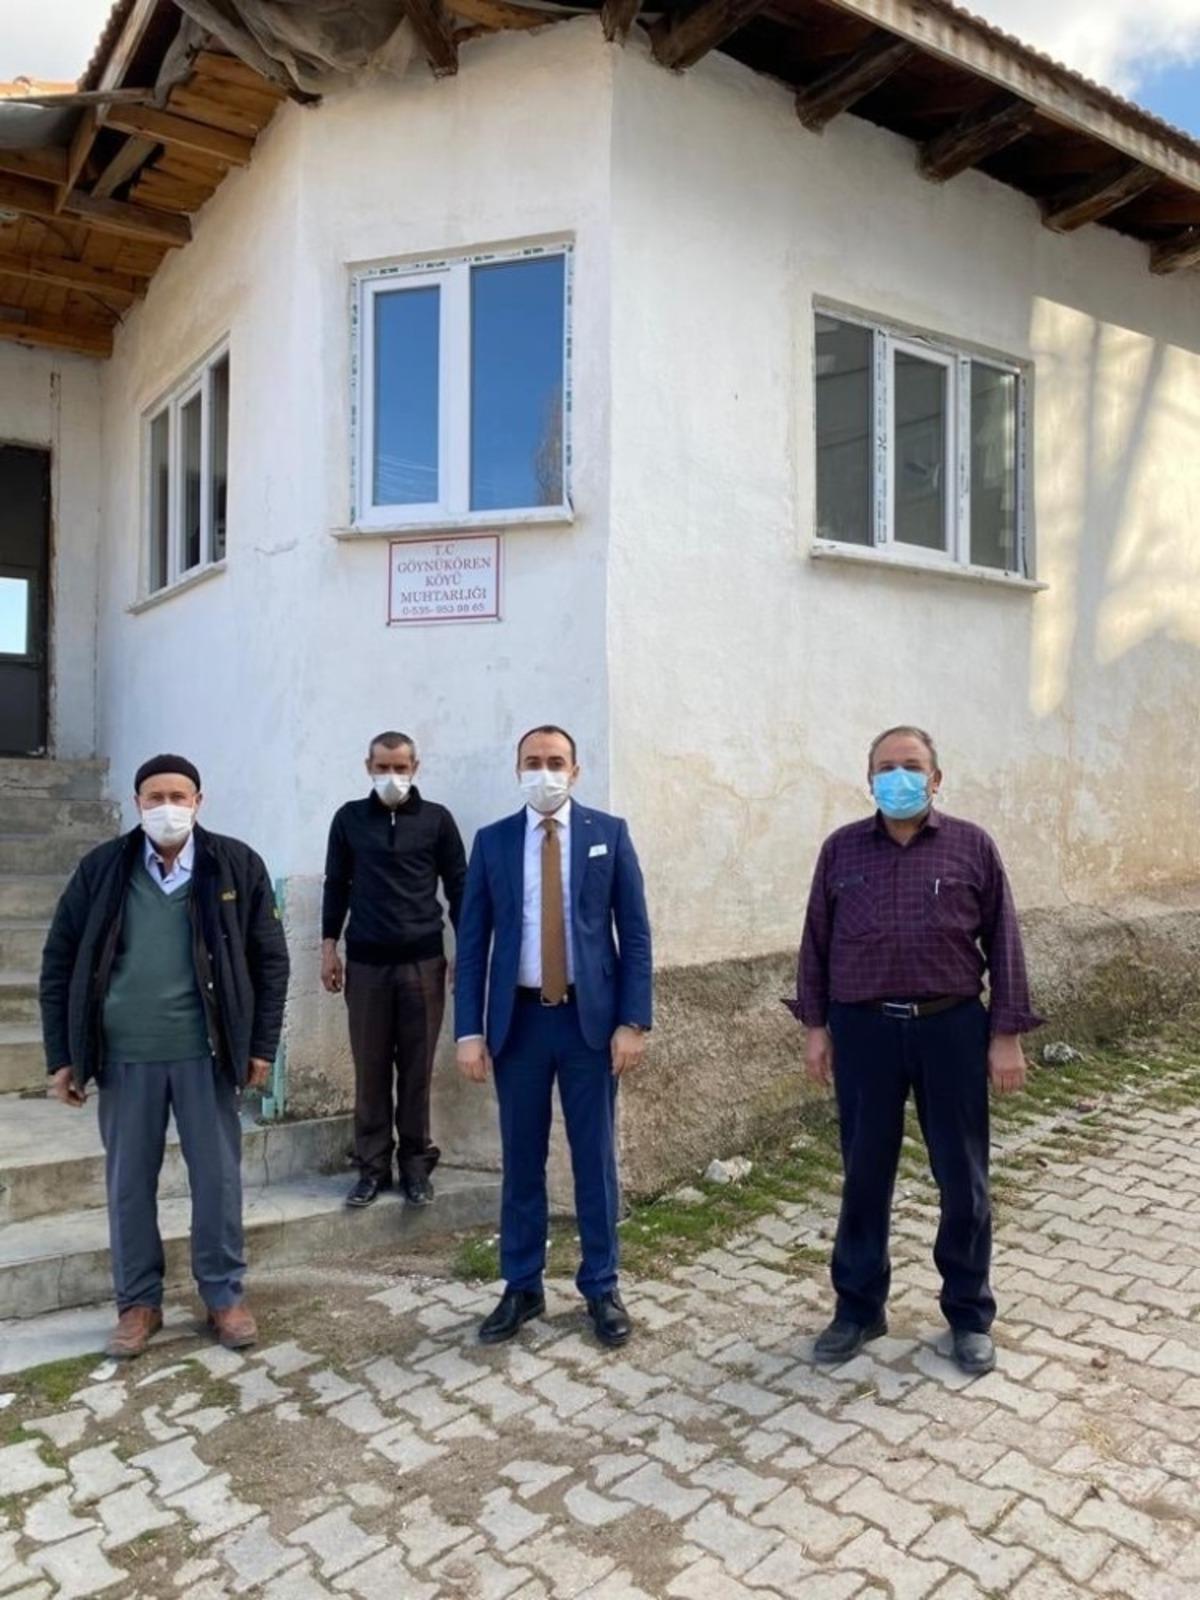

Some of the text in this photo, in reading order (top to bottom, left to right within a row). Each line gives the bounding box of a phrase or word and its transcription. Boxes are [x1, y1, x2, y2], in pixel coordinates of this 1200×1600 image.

[398, 556, 491, 573] GÖYNÜKÖREN
[425, 572, 462, 587] KÖYÜ
[400, 586, 487, 604] MUHTARLIĞI
